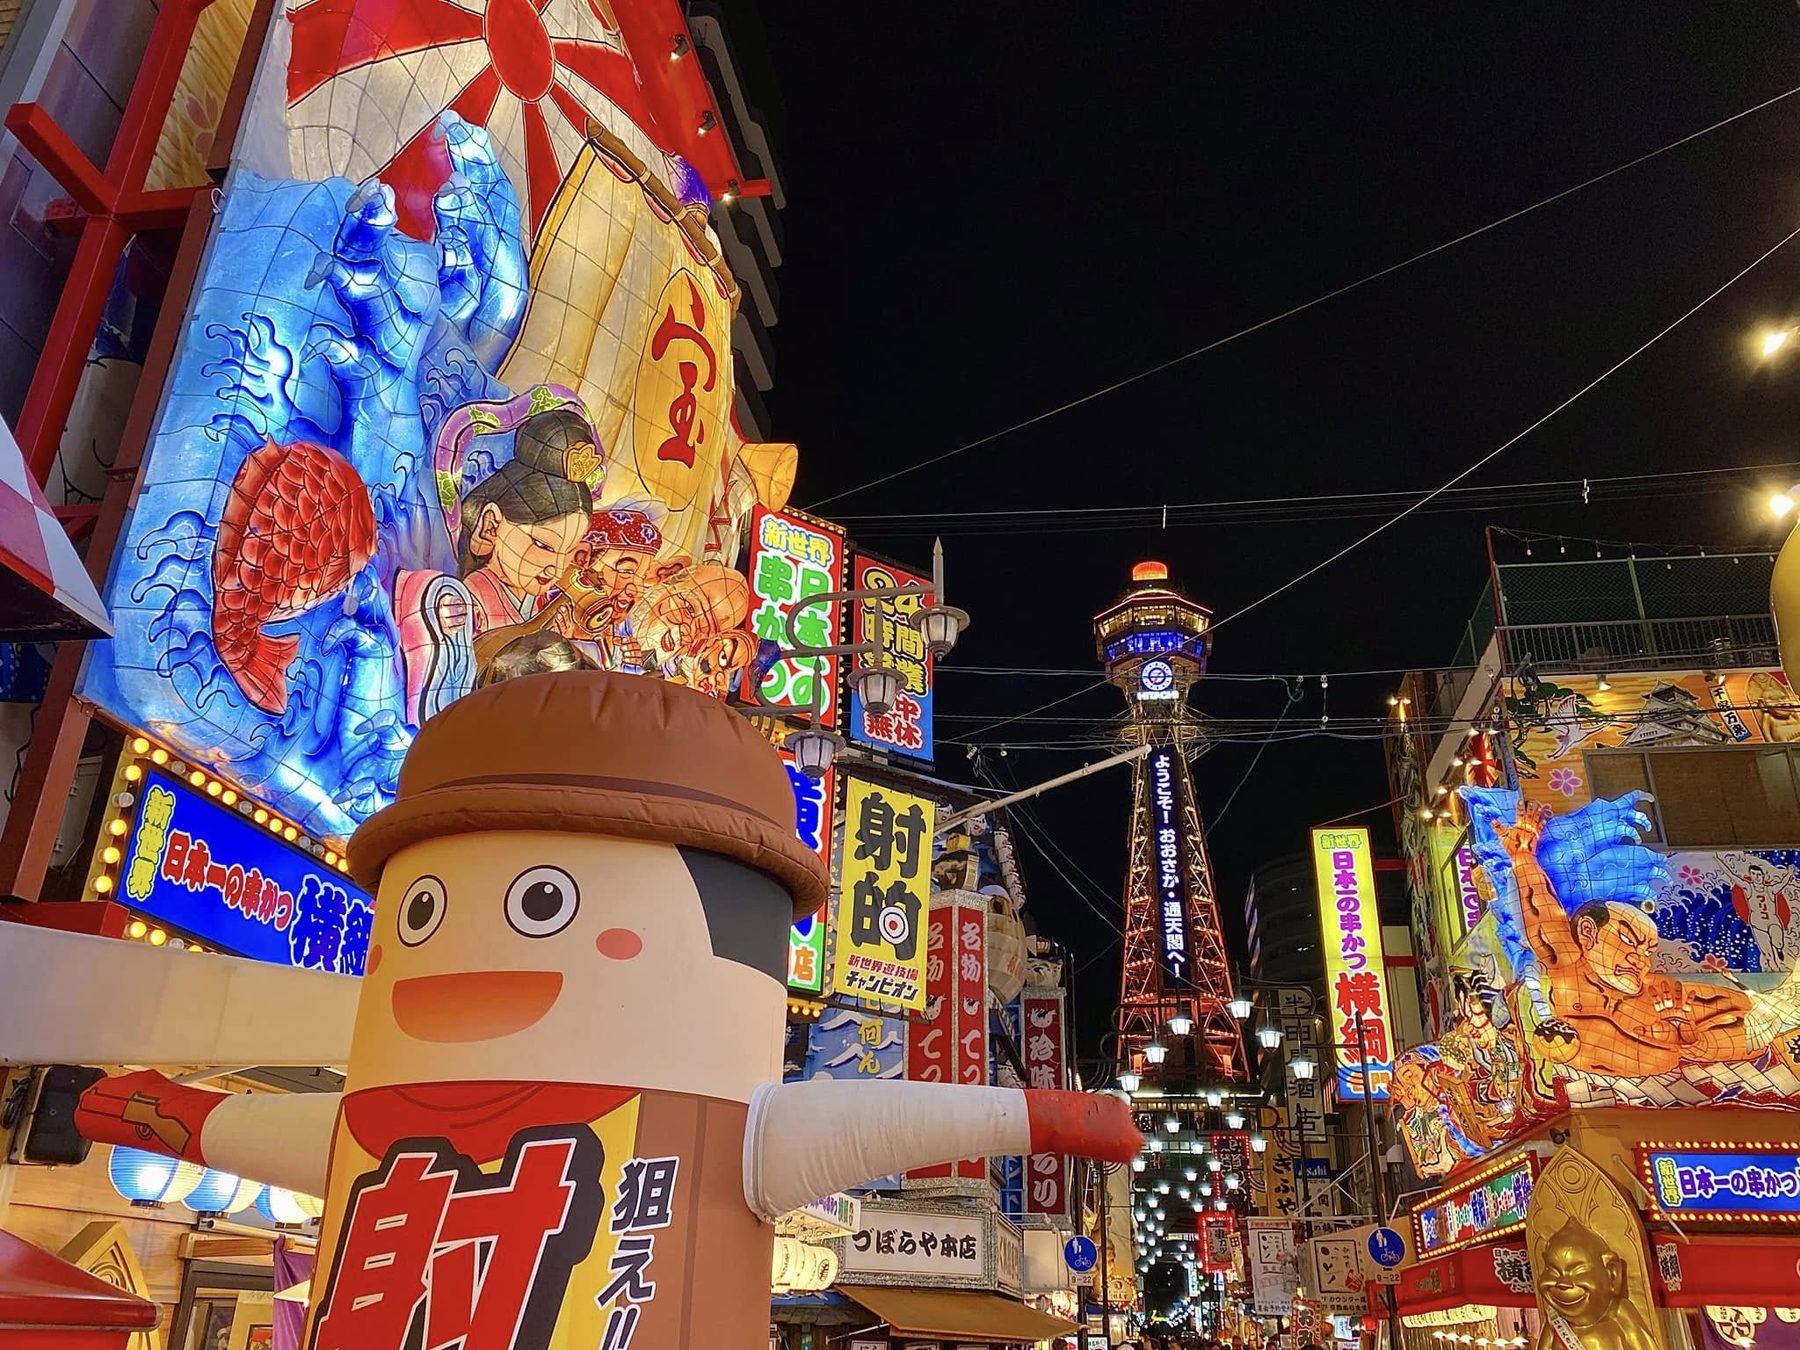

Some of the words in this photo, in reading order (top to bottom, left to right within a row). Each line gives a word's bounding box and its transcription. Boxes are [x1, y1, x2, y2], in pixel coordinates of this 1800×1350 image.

[763, 518, 832, 566] 新世界
[1136, 690, 1180, 700] HITACHI
[866, 712, 922, 749] 無休
[128, 785, 175, 900] 新世界
[1320, 833, 1362, 850] 新世界
[161, 829, 295, 931] 日本一の串かつ
[849, 791, 927, 961] 射的
[1332, 851, 1367, 970] 日本一の串かつ
[845, 969, 919, 1001] チャンピオン
[847, 953, 919, 982] 新世界遊技場
[1334, 970, 1389, 1066] 横綱
[1657, 1158, 1682, 1205] 新世界
[1678, 1168, 1798, 1196] 日本一の串かつ
[316, 1137, 579, 1350] 射
[852, 1227, 977, 1261] づぼらや本店
